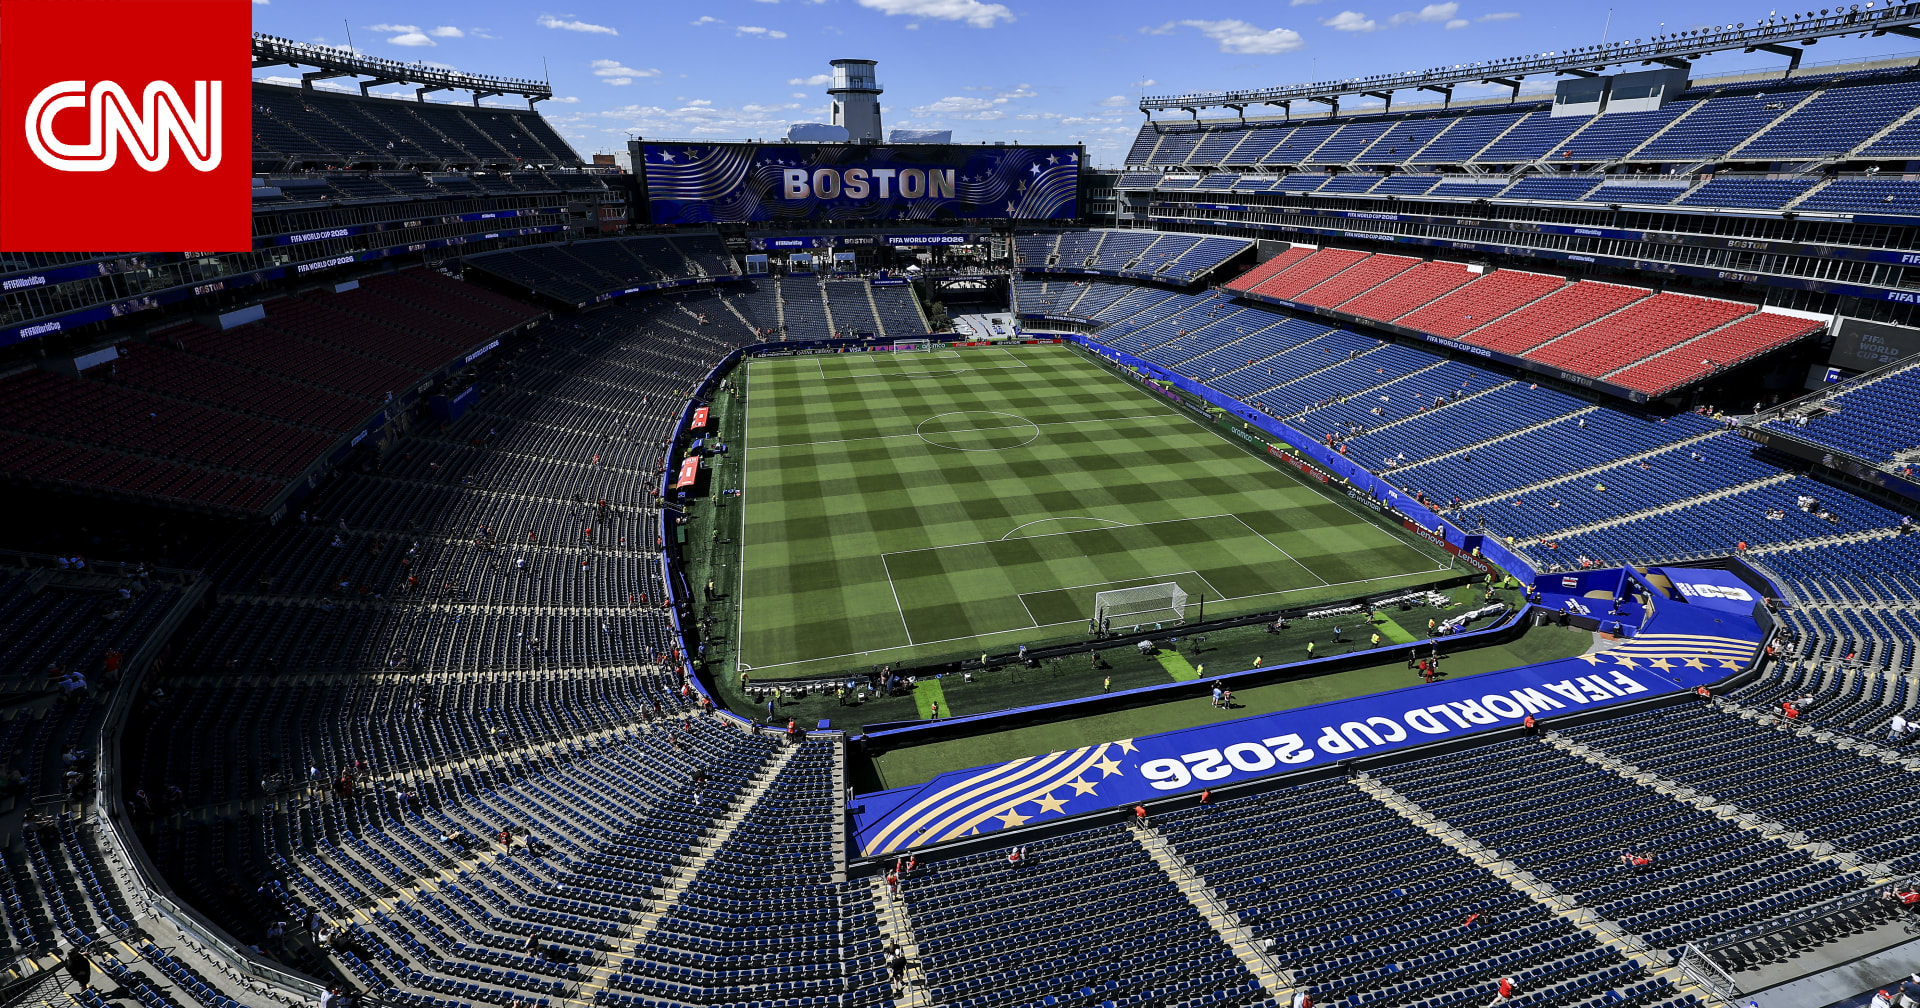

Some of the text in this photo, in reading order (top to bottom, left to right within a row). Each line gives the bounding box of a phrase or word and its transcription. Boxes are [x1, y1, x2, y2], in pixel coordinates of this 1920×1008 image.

[783, 168, 956, 199] BOSTON
[290, 229, 348, 243] FIFA WORLD CUP 2026
[1727, 239, 1768, 251] BOSTON
[297, 255, 354, 273] FIFA WORLD CUP 2026
[1901, 254, 1920, 264] FIF
[1718, 271, 1758, 283] BOSTON
[194, 281, 224, 296] BOSTON
[1888, 292, 1914, 303] FIFA
[1426, 335, 1492, 357] FIFA WORLD CUP 2026
[1862, 334, 1885, 344] FIFA
[1860, 342, 1899, 356] WORLD
[1856, 351, 1899, 363] CUP 20
[1560, 371, 1593, 387] BOSTON
[1231, 426, 1252, 442] aramco
[1739, 428, 1770, 444] STON
[1388, 490, 1398, 499] FIFA
[1416, 527, 1445, 548] Lenovo
[1457, 549, 1488, 573] Lenovo
[1139, 670, 1649, 791] FIFA WORLD CUP 2026
